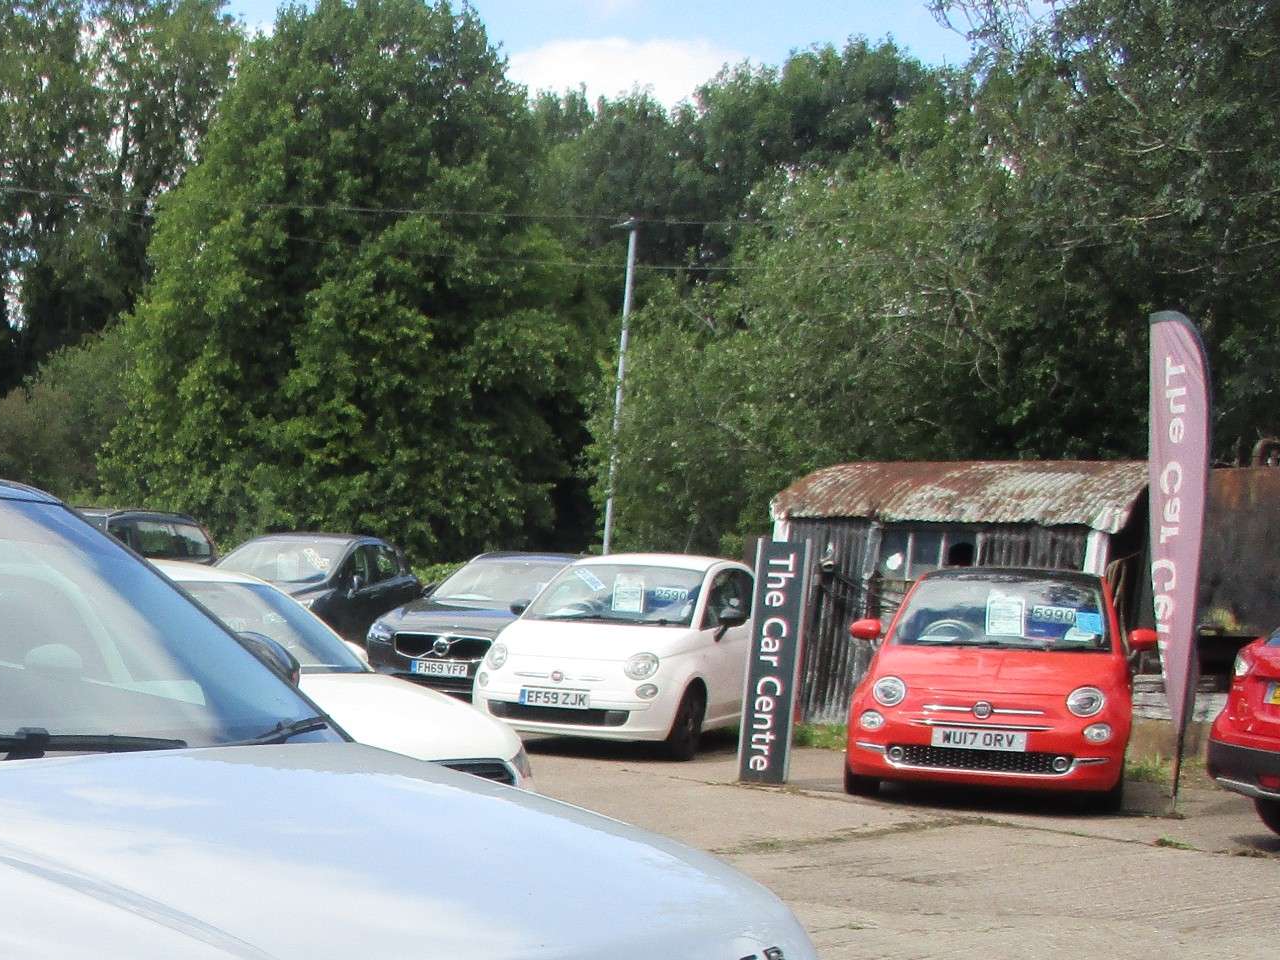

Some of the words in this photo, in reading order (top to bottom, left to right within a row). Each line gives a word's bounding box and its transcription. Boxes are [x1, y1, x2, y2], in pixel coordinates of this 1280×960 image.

[764, 553, 794, 608] The
[1033, 607, 1074, 621] 5990
[760, 617, 787, 668] Car
[417, 663, 443, 674] FH69
[446, 665, 466, 676] YFP
[526, 691, 559, 704] EF59
[561, 693, 587, 706] ZJK
[749, 676, 781, 772] Centre
[982, 733, 1015, 748] ORV
